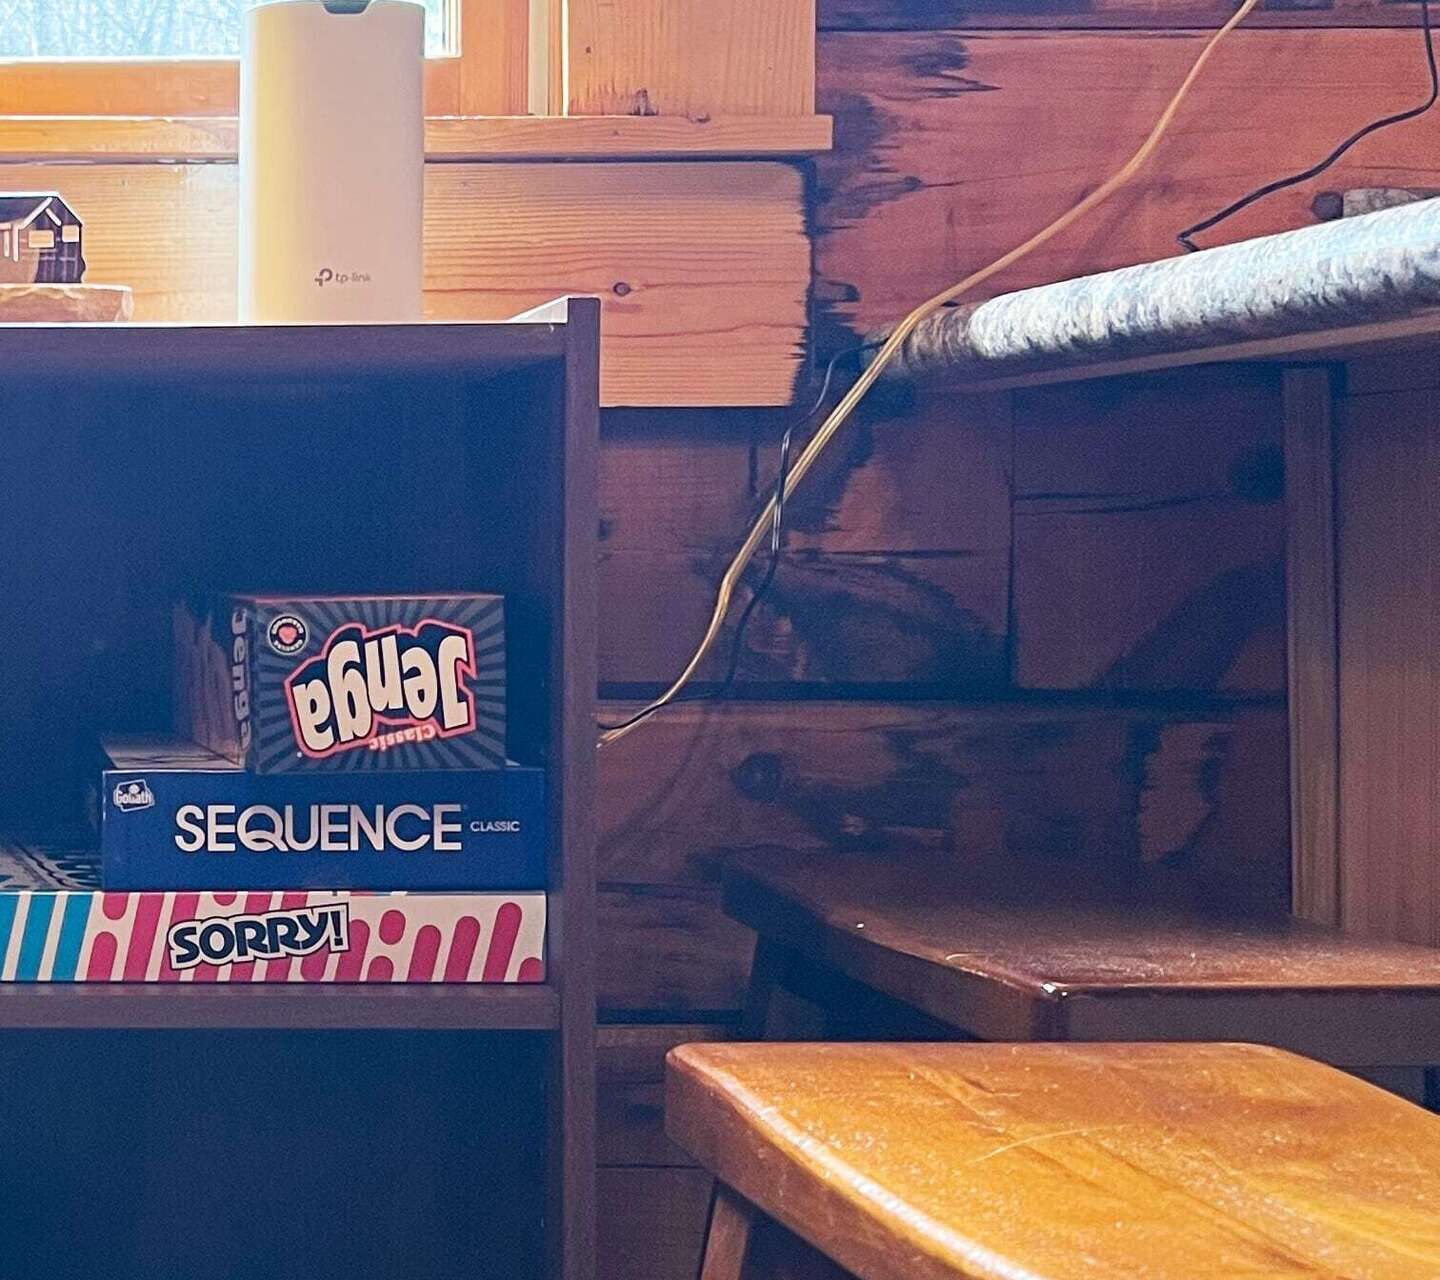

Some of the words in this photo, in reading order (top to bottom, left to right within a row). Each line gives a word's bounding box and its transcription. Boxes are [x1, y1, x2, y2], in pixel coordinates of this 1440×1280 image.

[335, 272, 371, 284] tp-link
[292, 635, 469, 751] Jenga
[368, 724, 436, 751] Classic
[174, 804, 462, 852] SEQUENCE
[470, 821, 520, 833] CLASSIC
[173, 910, 344, 964] SORRY!
